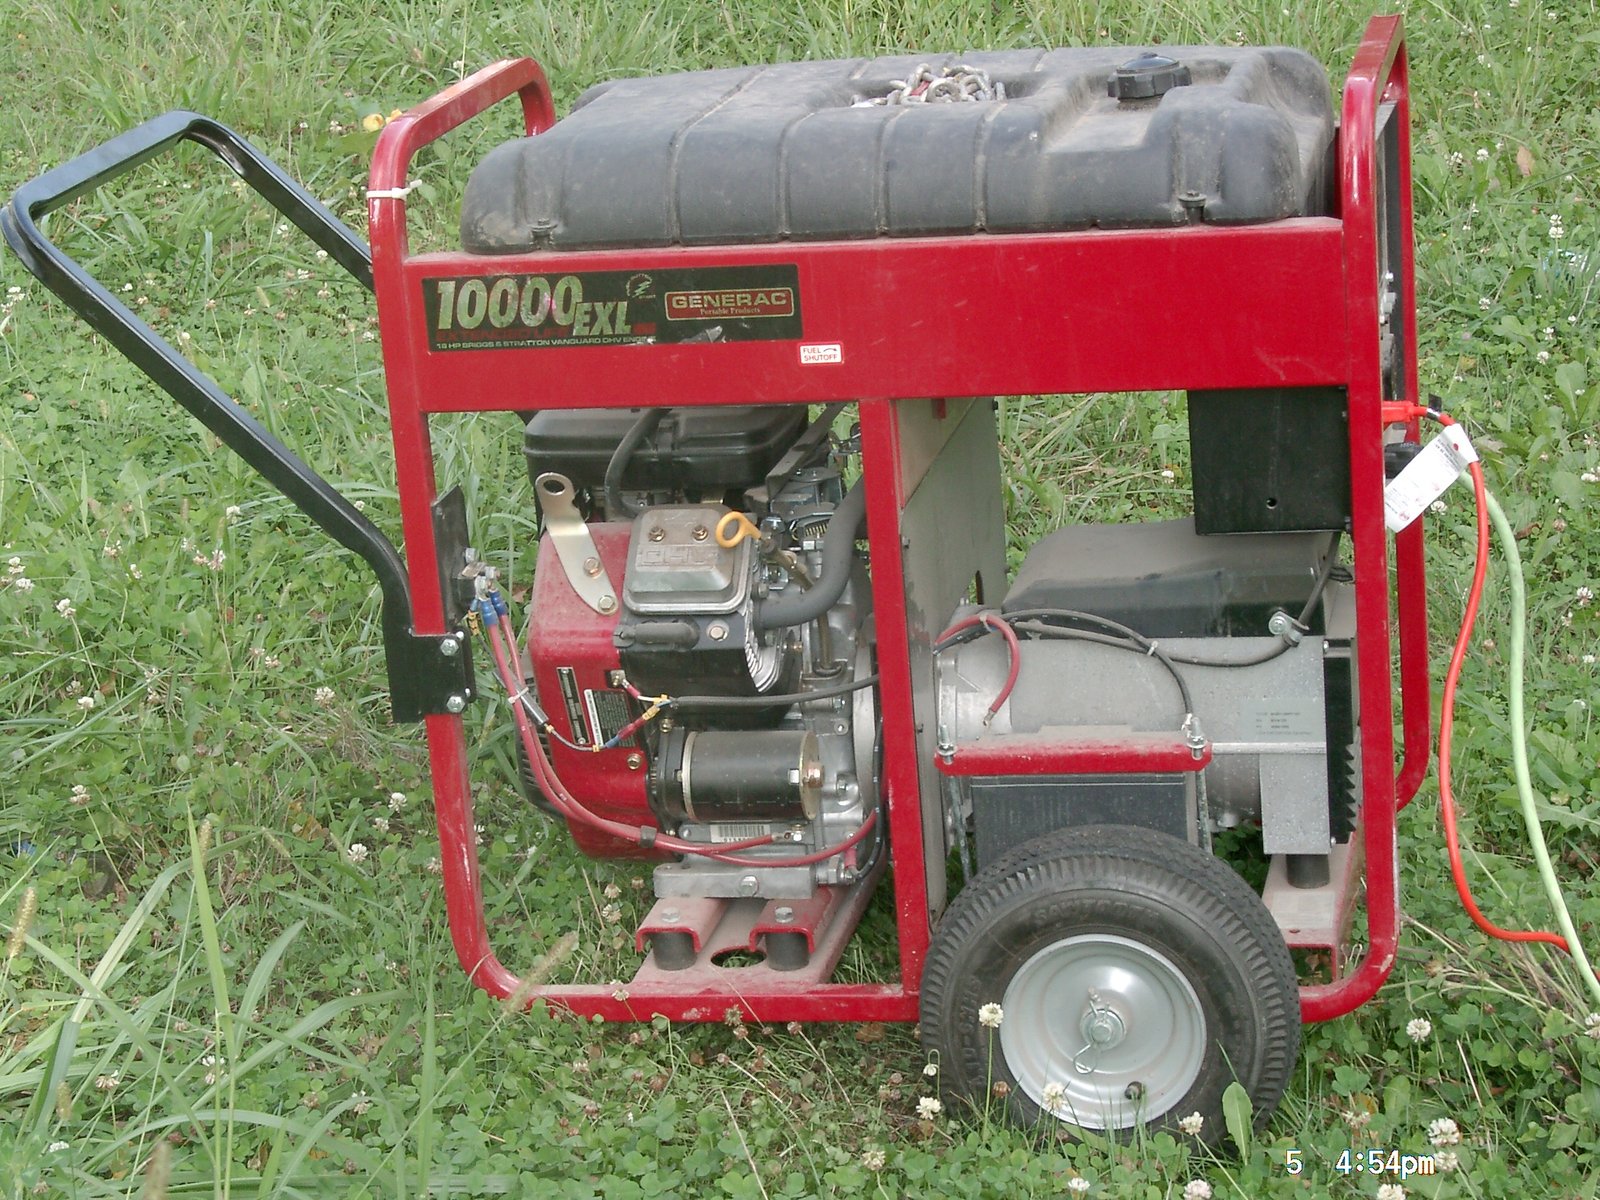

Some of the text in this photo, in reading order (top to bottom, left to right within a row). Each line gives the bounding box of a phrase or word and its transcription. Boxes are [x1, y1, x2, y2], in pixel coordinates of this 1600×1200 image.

[437, 275, 631, 336] 10000 EXL
[672, 292, 787, 309] GENERAC
[700, 306, 760, 316] Portable Products
[462, 341, 495, 349] BRIGGS
[503, 337, 550, 347] STRATTON
[551, 336, 601, 346] VANGUARD
[602, 336, 622, 344] OHV
[803, 353, 838, 362] SHUTOFF
